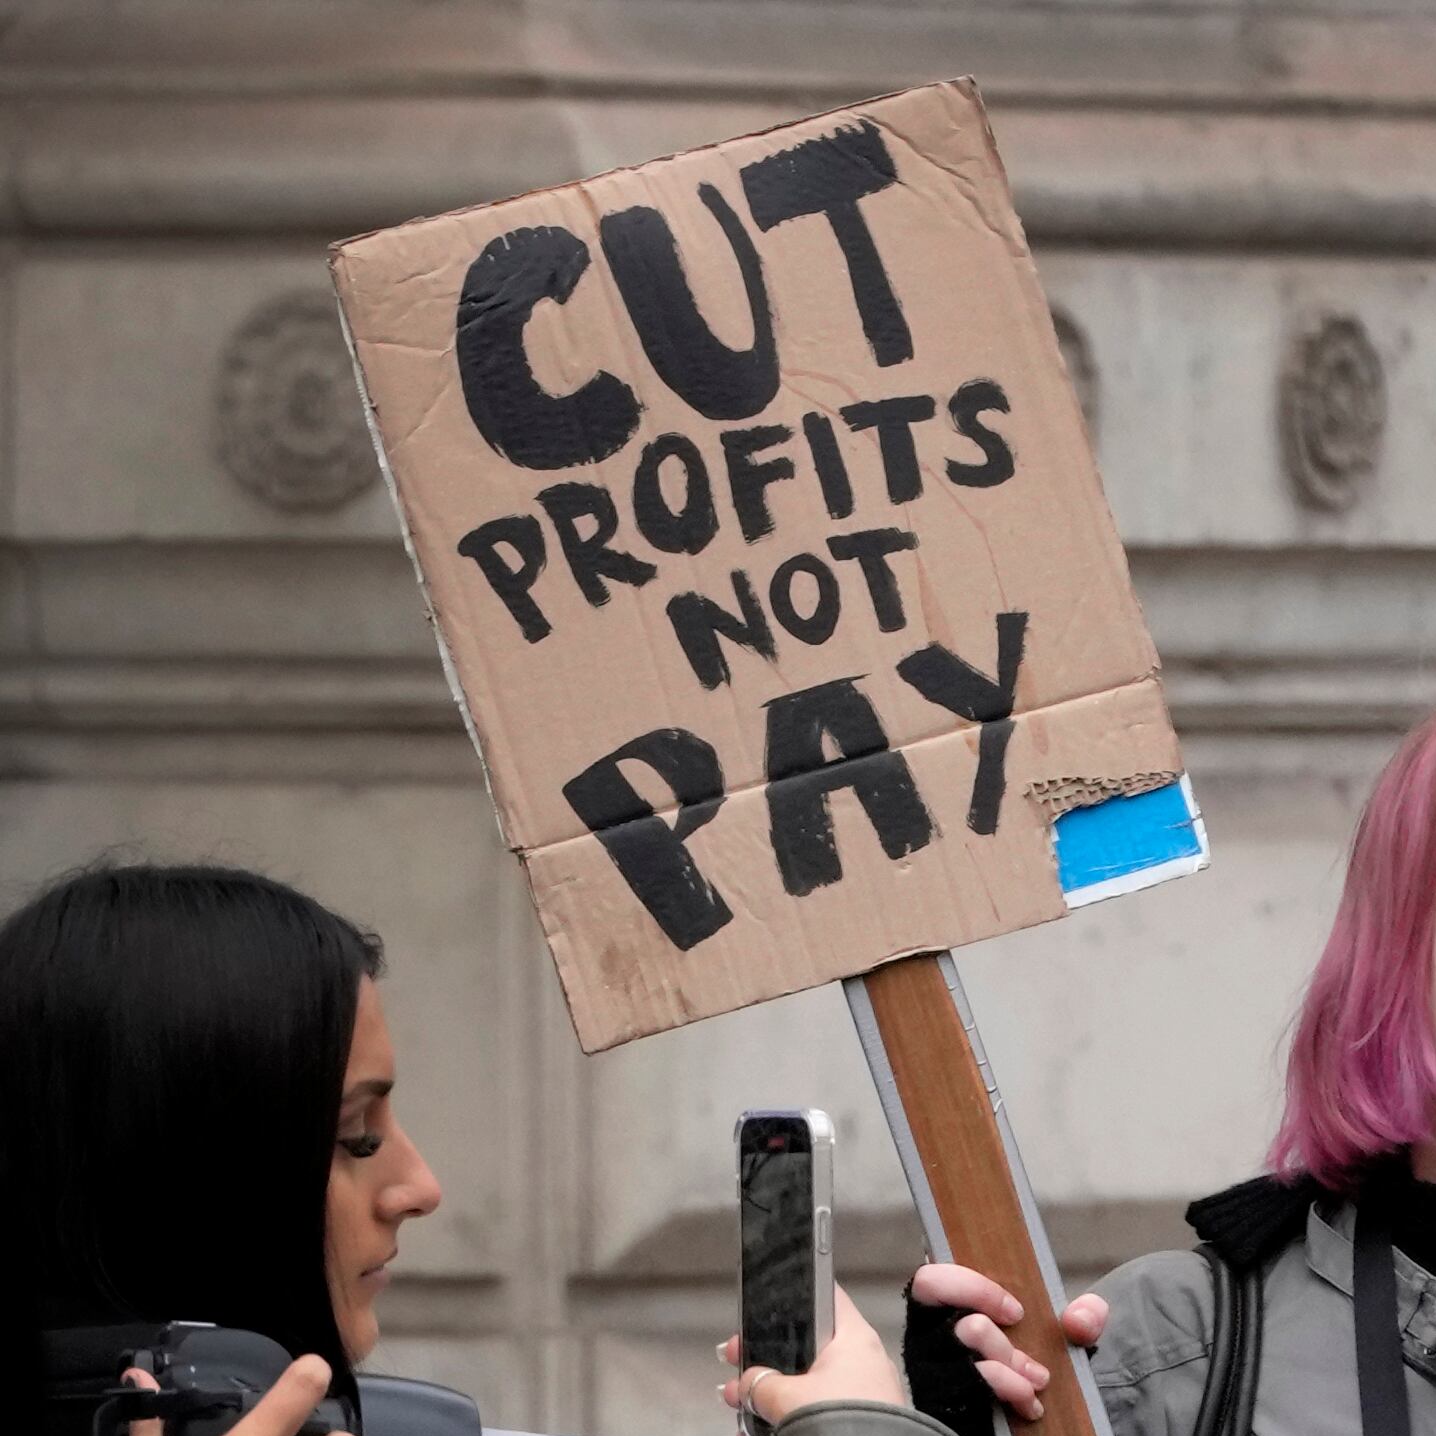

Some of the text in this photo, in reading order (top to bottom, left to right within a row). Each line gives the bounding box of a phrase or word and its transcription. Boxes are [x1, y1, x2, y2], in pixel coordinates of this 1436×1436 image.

[455, 118, 914, 471] CUT
[457, 377, 1015, 644] PROFITS
[666, 526, 919, 690] NOT
[561, 611, 1029, 951] PAY
